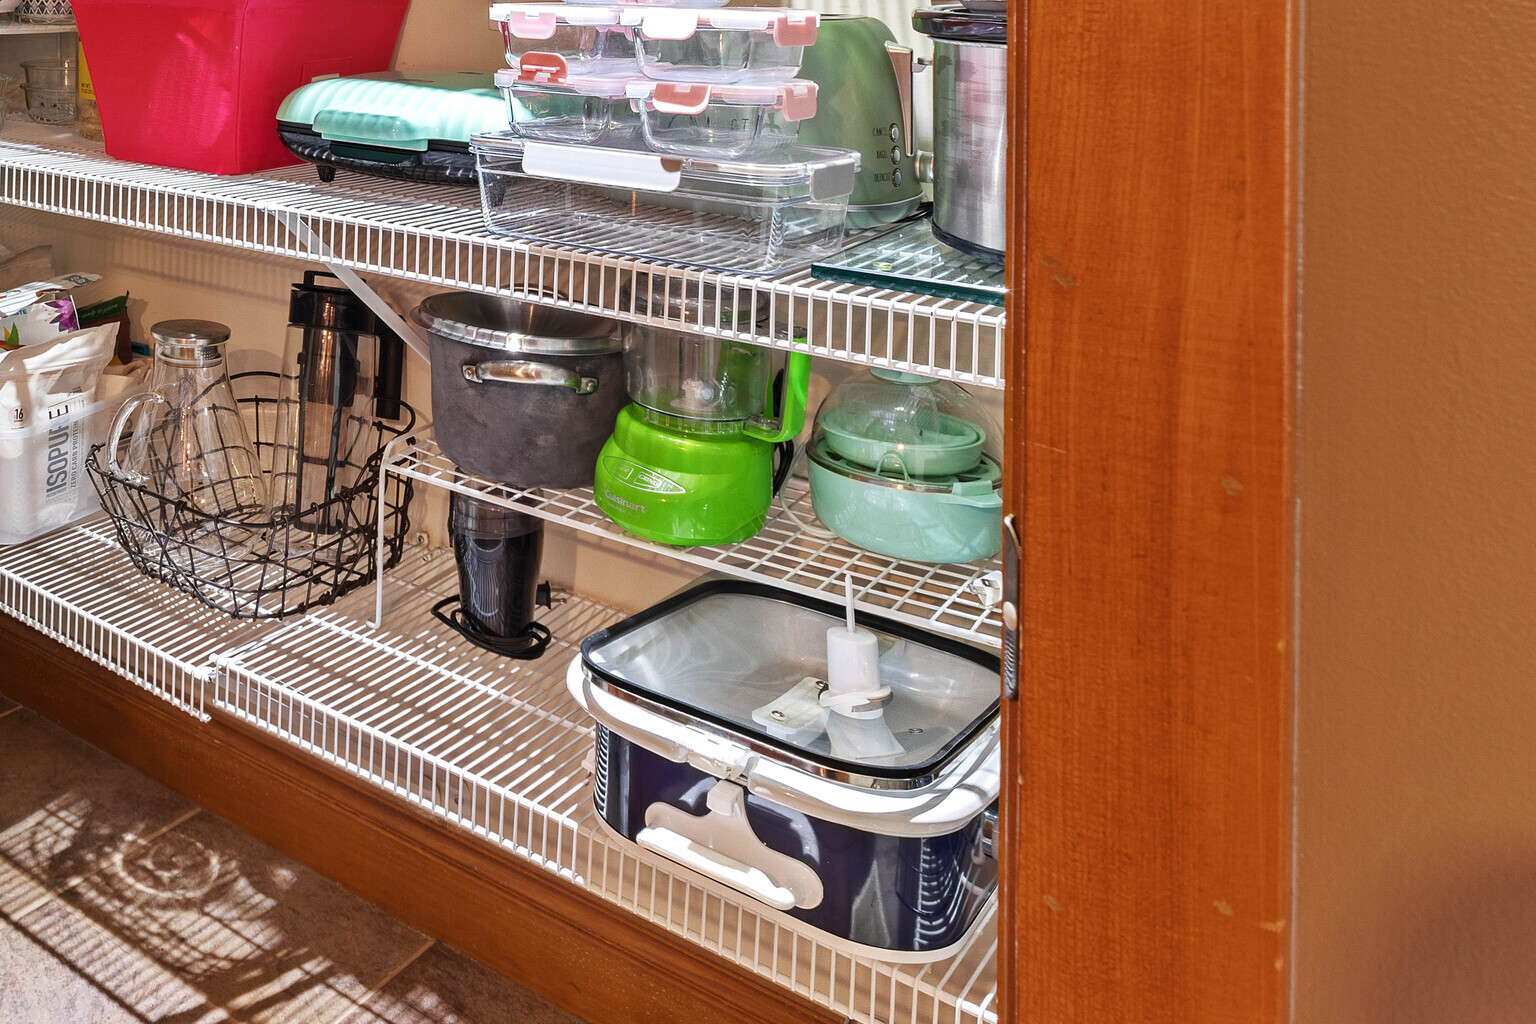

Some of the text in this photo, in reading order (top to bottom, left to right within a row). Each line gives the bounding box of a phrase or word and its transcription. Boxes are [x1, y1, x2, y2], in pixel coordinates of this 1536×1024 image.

[15, 408, 24, 419] 16
[72, 421, 80, 452] PROTEIN
[605, 489, 646, 513] Cuisinart
